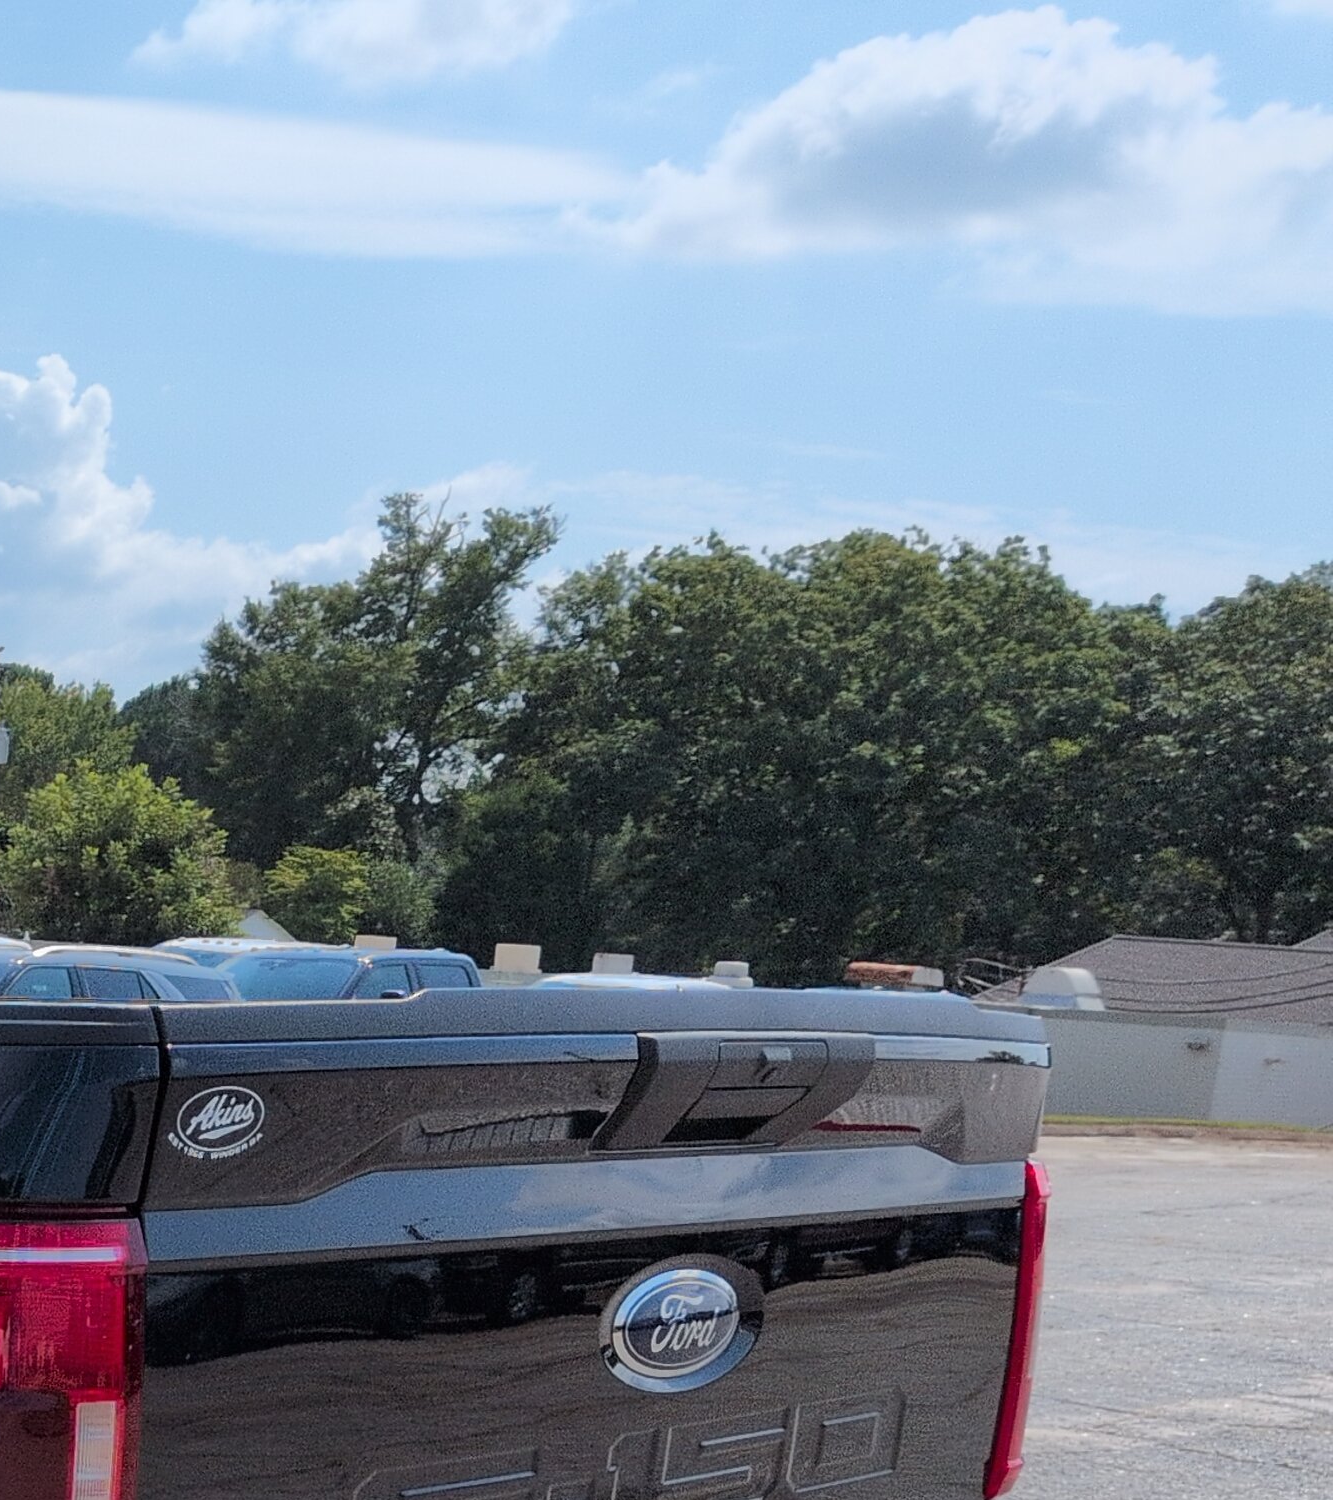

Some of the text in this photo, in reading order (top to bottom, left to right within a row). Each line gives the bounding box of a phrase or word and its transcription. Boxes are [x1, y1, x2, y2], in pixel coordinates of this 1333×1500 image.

[186, 1094, 255, 1138] Akins
[167, 1132, 185, 1150] EST
[210, 1142, 249, 1160] WINDER
[650, 1294, 720, 1353] Ford
